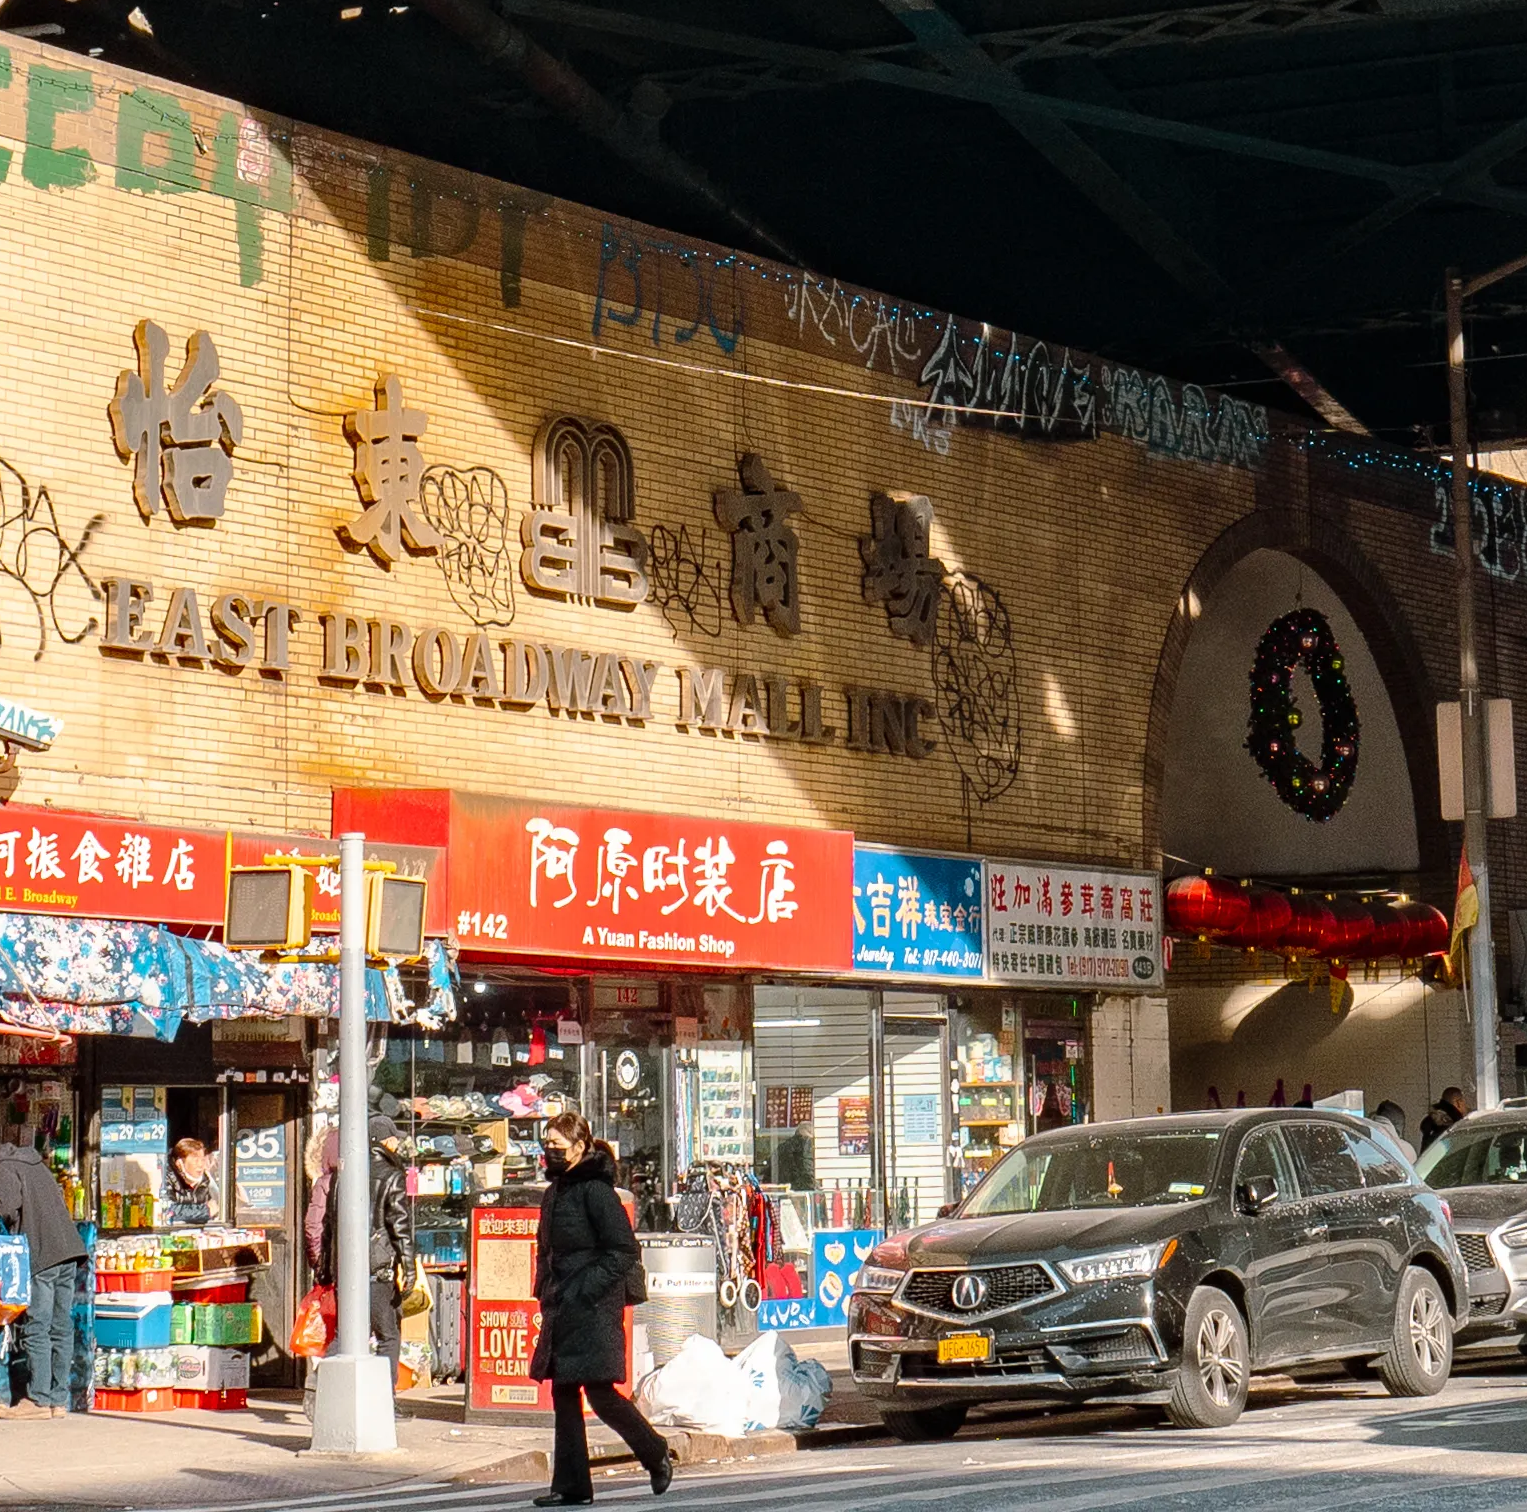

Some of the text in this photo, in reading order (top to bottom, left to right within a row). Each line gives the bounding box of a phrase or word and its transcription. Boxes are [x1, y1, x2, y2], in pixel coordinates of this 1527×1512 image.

[100, 576, 939, 759] EAST BROADWAY MALL INC
[4, 886, 17, 901] E.
[22, 888, 78, 909] Broadway
[457, 910, 509, 940] #142
[582, 925, 735, 959] A Yuan Fashion Shop
[856, 943, 895, 971] Jewelry
[615, 985, 638, 1004] 142
[118, 1123, 165, 1141] 29 29
[236, 1128, 280, 1160] 35
[479, 1310, 510, 1329] SHOW
[479, 1328, 529, 1359] LOVE
[495, 1359, 530, 1377] CLEAN
